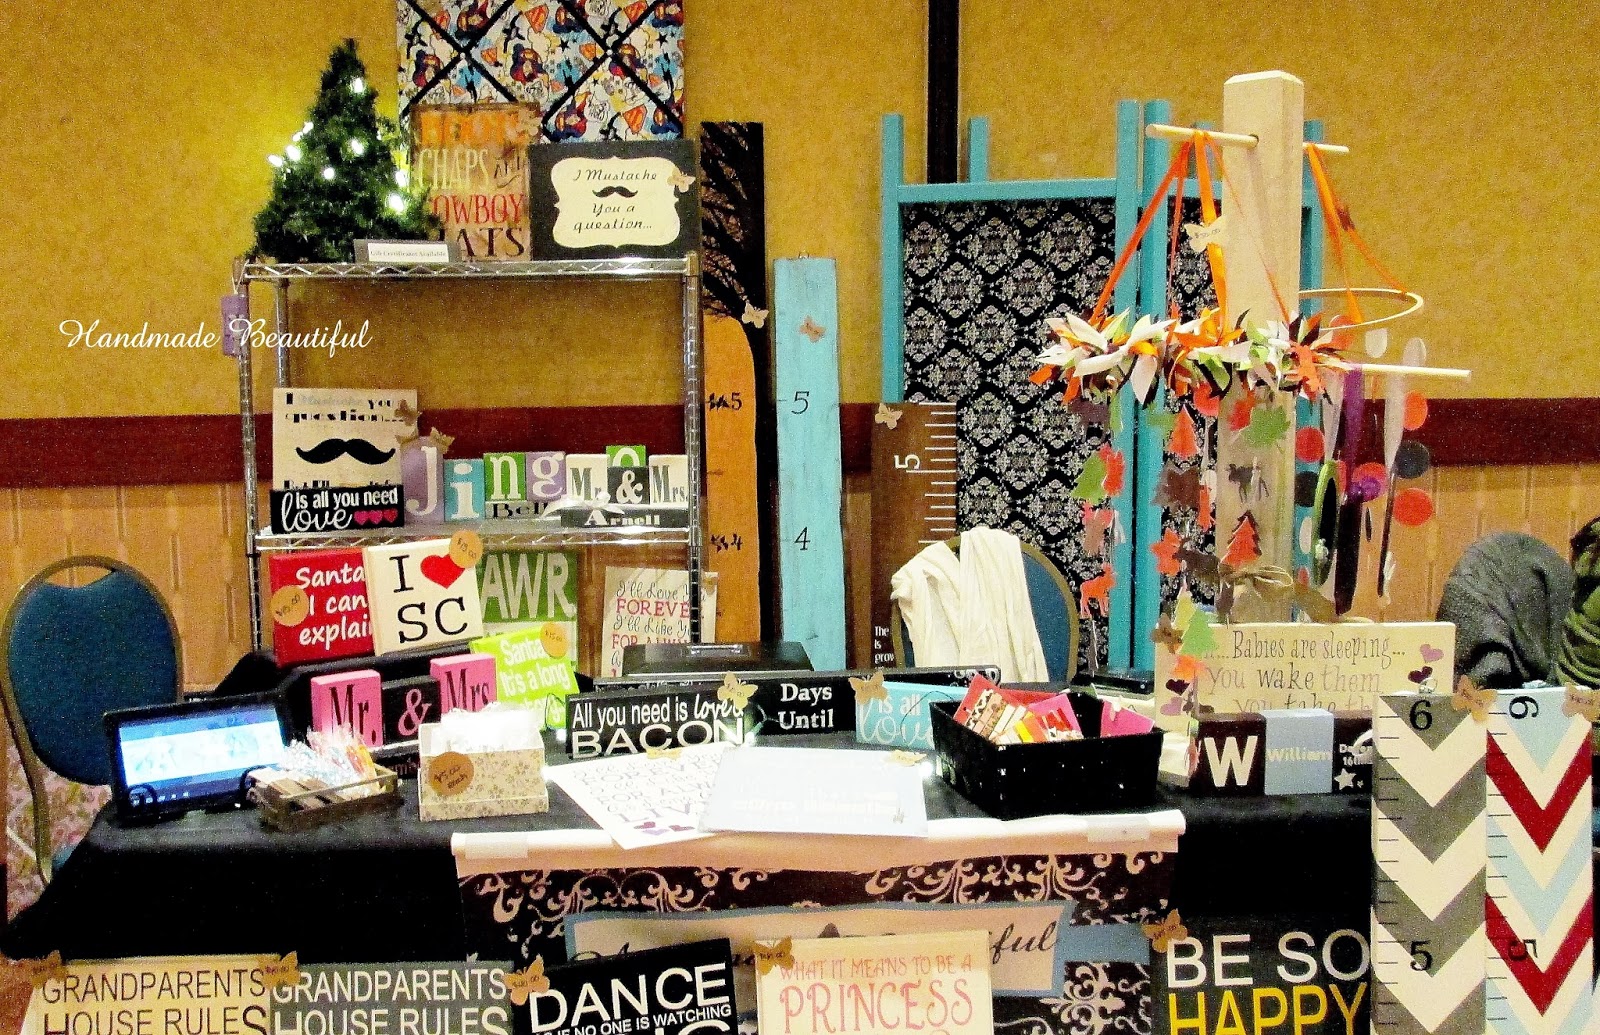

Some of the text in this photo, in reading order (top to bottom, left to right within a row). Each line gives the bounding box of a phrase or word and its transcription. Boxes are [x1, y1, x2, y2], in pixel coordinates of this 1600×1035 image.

[586, 168, 657, 182] Mustache
[431, 193, 525, 225] OWBOY
[592, 202, 636, 218] You a
[438, 227, 525, 258] ATS
[790, 390, 811, 415] 5
[296, 487, 398, 511] is all you need
[615, 469, 644, 505] &
[281, 491, 353, 532] love
[794, 526, 811, 551] 4
[296, 562, 365, 589] Santa
[389, 554, 414, 593] I
[309, 594, 367, 615] I can
[397, 596, 468, 644] SC
[616, 598, 692, 619] FOREVE
[299, 613, 371, 650] explai
[874, 626, 889, 637] The
[1233, 629, 1285, 659] Babies
[1290, 639, 1317, 659] are
[527, 670, 539, 690] a
[535, 662, 571, 690] long
[1256, 662, 1314, 691] wake
[780, 683, 832, 706] Days
[900, 693, 920, 716] all
[398, 688, 432, 736] &
[572, 702, 592, 729] All
[598, 706, 626, 733] you
[632, 697, 670, 725] need
[675, 696, 688, 722] is
[778, 708, 834, 730] Until
[1409, 700, 1433, 731] 6
[572, 717, 743, 760] BACON
[1203, 735, 1259, 788] W
[780, 954, 973, 981] WHAT IT MEANS TO BE A
[1167, 928, 1370, 988] BE SO
[1409, 940, 1433, 971] 5
[42, 968, 266, 1004] GRANDPARENTS
[272, 968, 508, 1003] GRANDPARENTS
[529, 962, 730, 1033] DANCE
[44, 1004, 268, 1035] HOUSE RULES
[274, 1005, 509, 1035] HOUSE RULES
[600, 1018, 632, 1035] ONE
[636, 1016, 650, 1031] IS
[652, 1004, 732, 1029] WATCHING
[778, 978, 973, 1034] PRINCESS
[1168, 981, 1368, 1035] HAPPY
